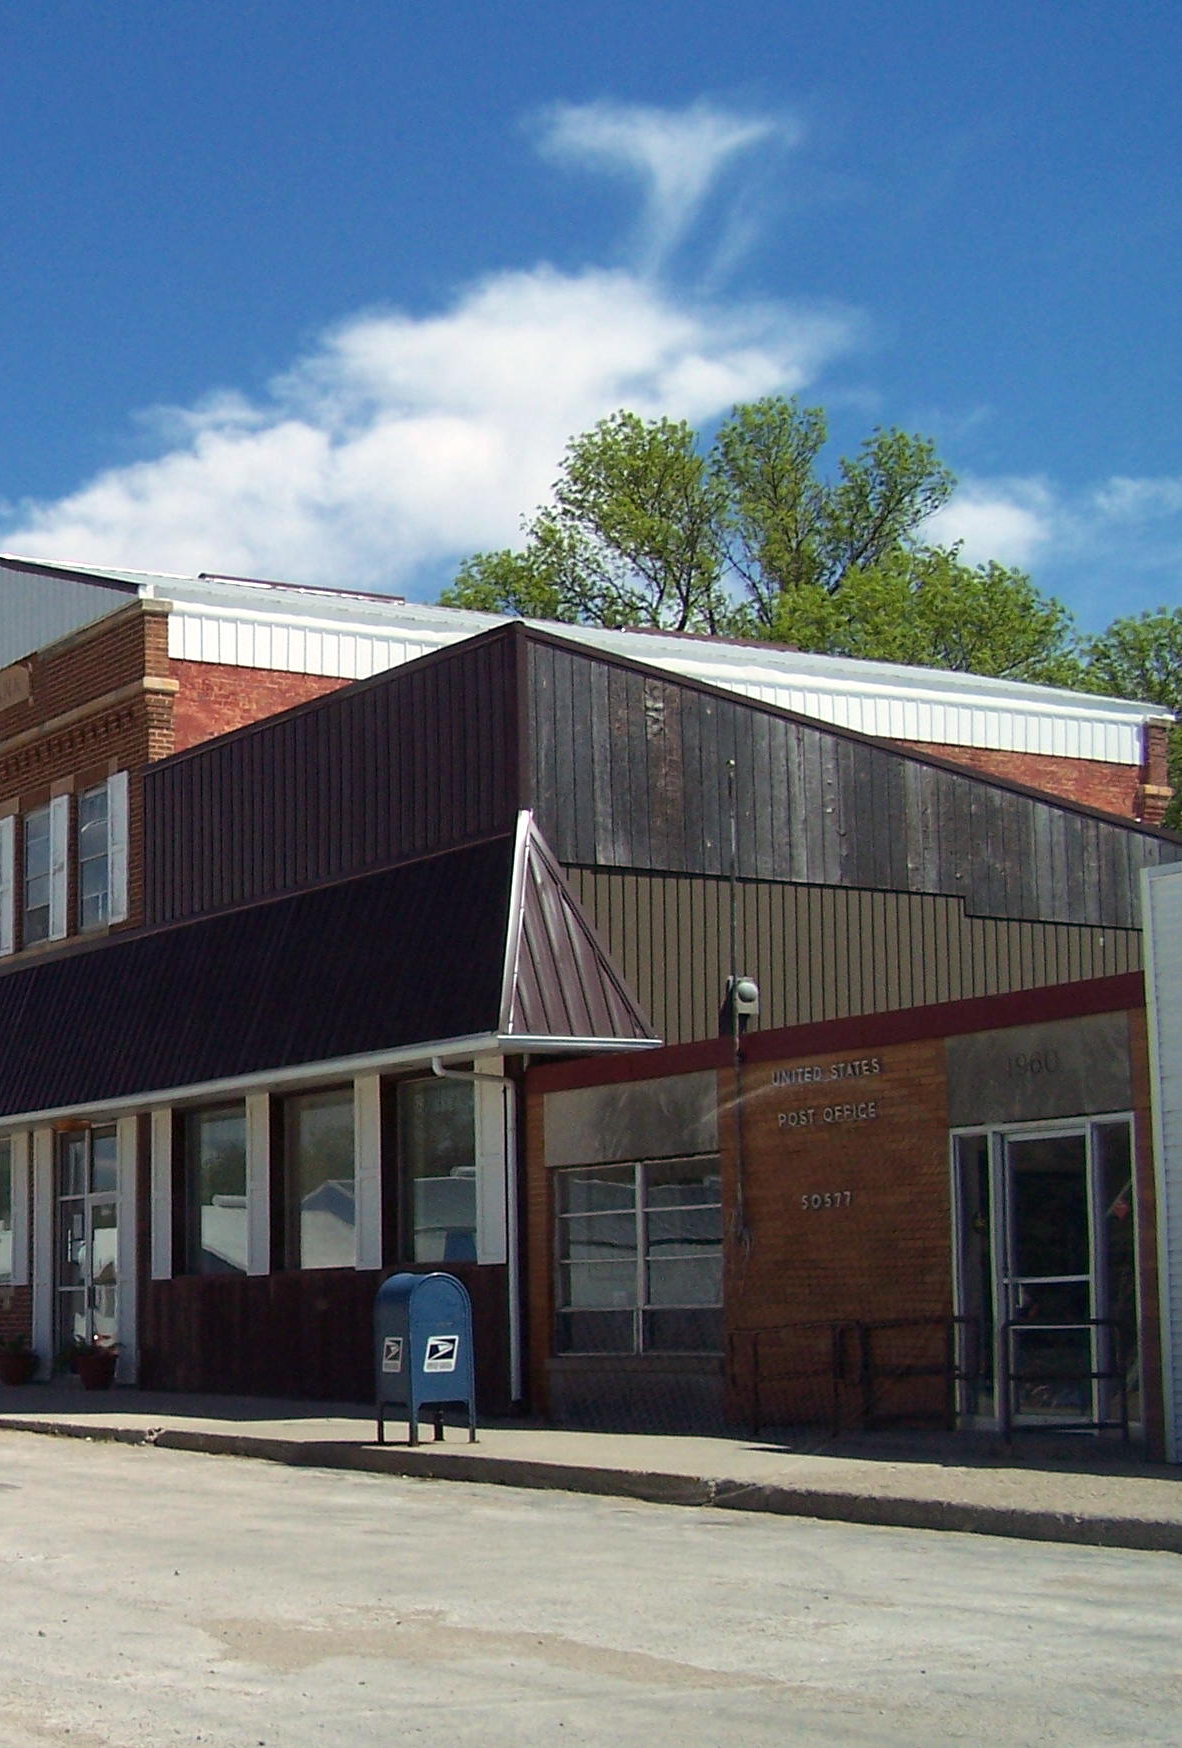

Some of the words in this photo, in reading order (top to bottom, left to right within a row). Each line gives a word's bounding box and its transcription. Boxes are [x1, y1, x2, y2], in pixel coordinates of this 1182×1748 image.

[771, 1067, 822, 1087] UNITED
[830, 1058, 881, 1080] STATES
[778, 1109, 815, 1128] POST
[823, 1102, 878, 1122] OFFICE
[801, 1190, 852, 1211] 50577
